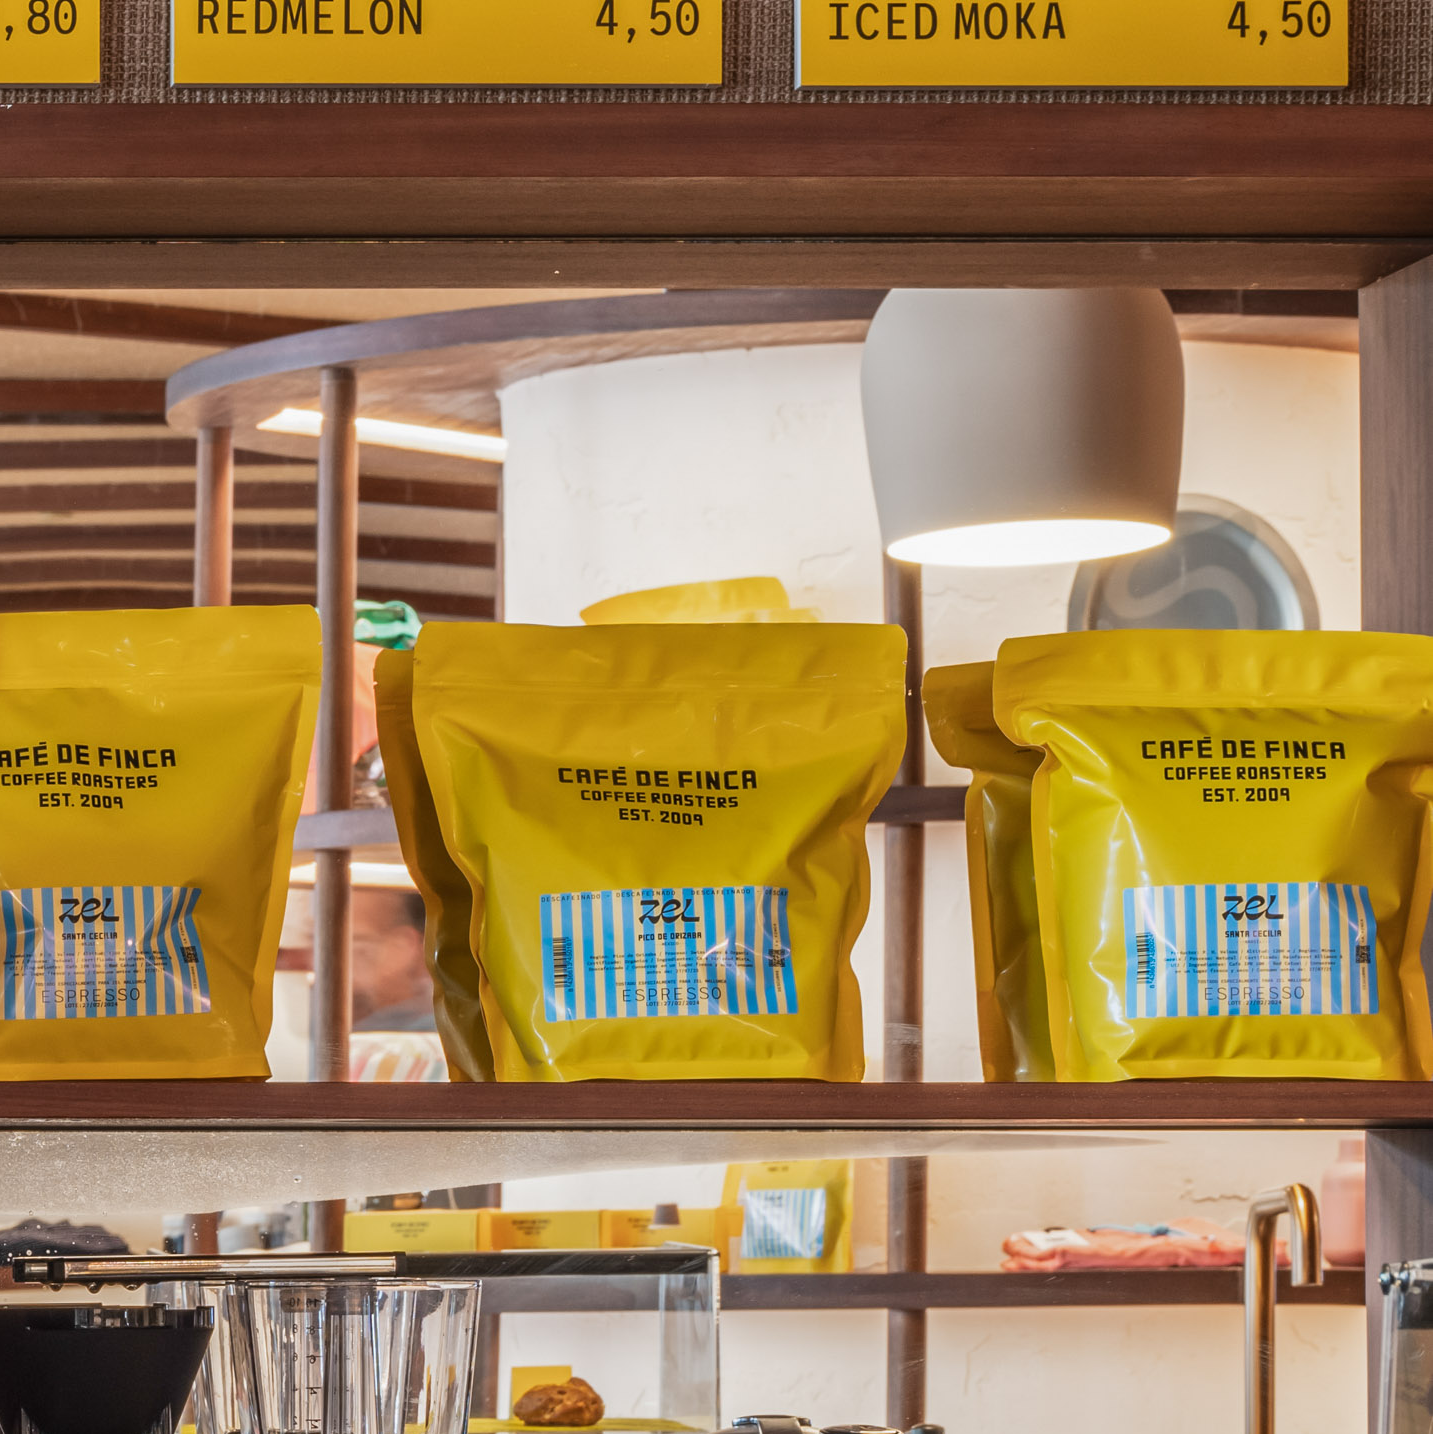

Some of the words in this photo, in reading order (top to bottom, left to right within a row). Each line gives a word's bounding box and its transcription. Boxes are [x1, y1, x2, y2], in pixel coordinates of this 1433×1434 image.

[196, 0, 423, 35] REDMELON
[594, 0, 700, 43] 4,50
[828, 2, 938, 40] ICED
[953, 2, 1067, 40] MOKA
[1226, 1, 1331, 45] 4,50
[56, 743, 90, 765] DE
[98, 746, 176, 769] FINCA
[1140, 737, 1213, 760] CAFÉ
[1221, 740, 1256, 759] DE
[1264, 740, 1346, 760] FINCA
[0, 772, 67, 786] COFFEE
[71, 772, 158, 789] ROASTERS
[557, 766, 626, 787] CAFÉ
[635, 769, 670, 788] DE
[678, 769, 757, 790] FINCA
[1163, 766, 1231, 781] COFFEE
[1236, 766, 1327, 781] ROASTERS
[38, 793, 75, 808] EST.
[80, 794, 124, 809] 2009
[580, 789, 646, 803] COFFEE
[650, 792, 739, 808] ROASTERS
[1202, 788, 1240, 802] EST.
[1244, 788, 1290, 802] 2009
[618, 808, 654, 822] EST.
[659, 810, 704, 826] 2009
[61, 932, 87, 941] SANTA
[89, 931, 118, 940] CECILIA
[638, 933, 656, 941] PICO
[658, 932, 668, 940] DE
[670, 931, 702, 940] ORIZABA
[1225, 930, 1250, 938] SANTA
[1253, 929, 1282, 938] CECILIA
[41, 987, 140, 1004] ESPRESSO
[622, 986, 722, 1002] ESPRESSO
[1204, 986, 1305, 1001] ESPRESSO
